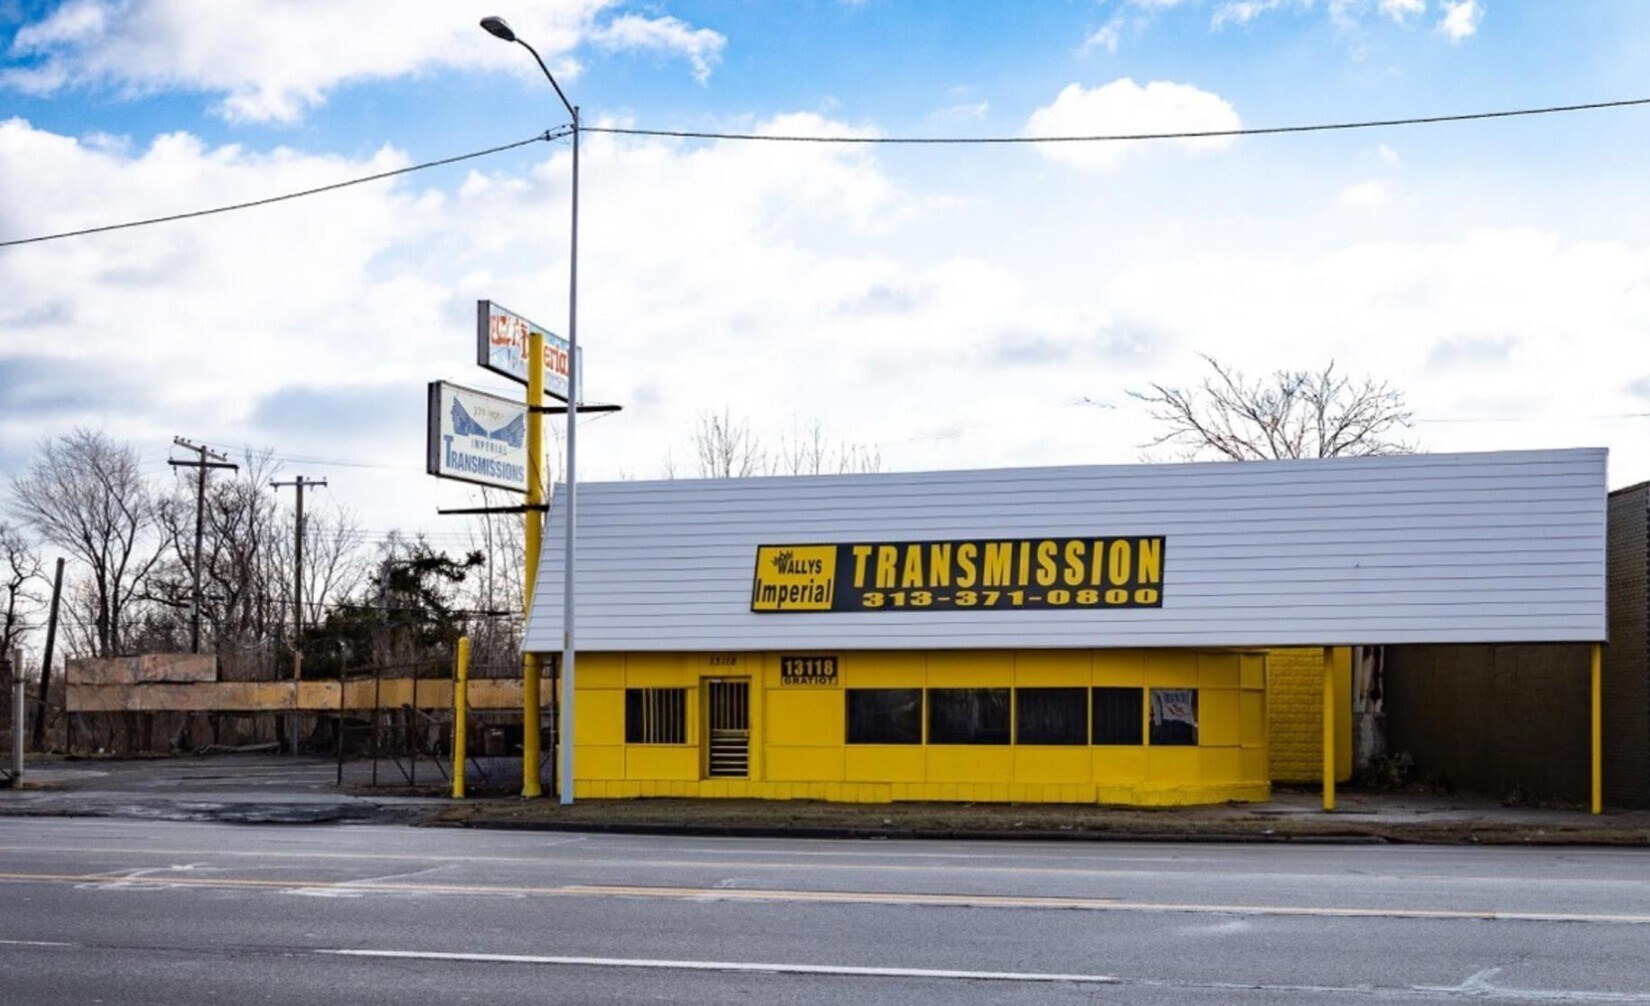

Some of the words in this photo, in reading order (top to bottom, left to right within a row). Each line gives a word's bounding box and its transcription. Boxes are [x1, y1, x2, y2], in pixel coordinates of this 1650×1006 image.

[776, 559, 822, 574] WALLYS
[852, 539, 1161, 588] TRANSMISSION
[755, 579, 831, 609] Imperial
[862, 588, 1159, 607] 313-371-0800
[783, 659, 834, 676] 13118
[782, 676, 837, 686] GRATIOT
